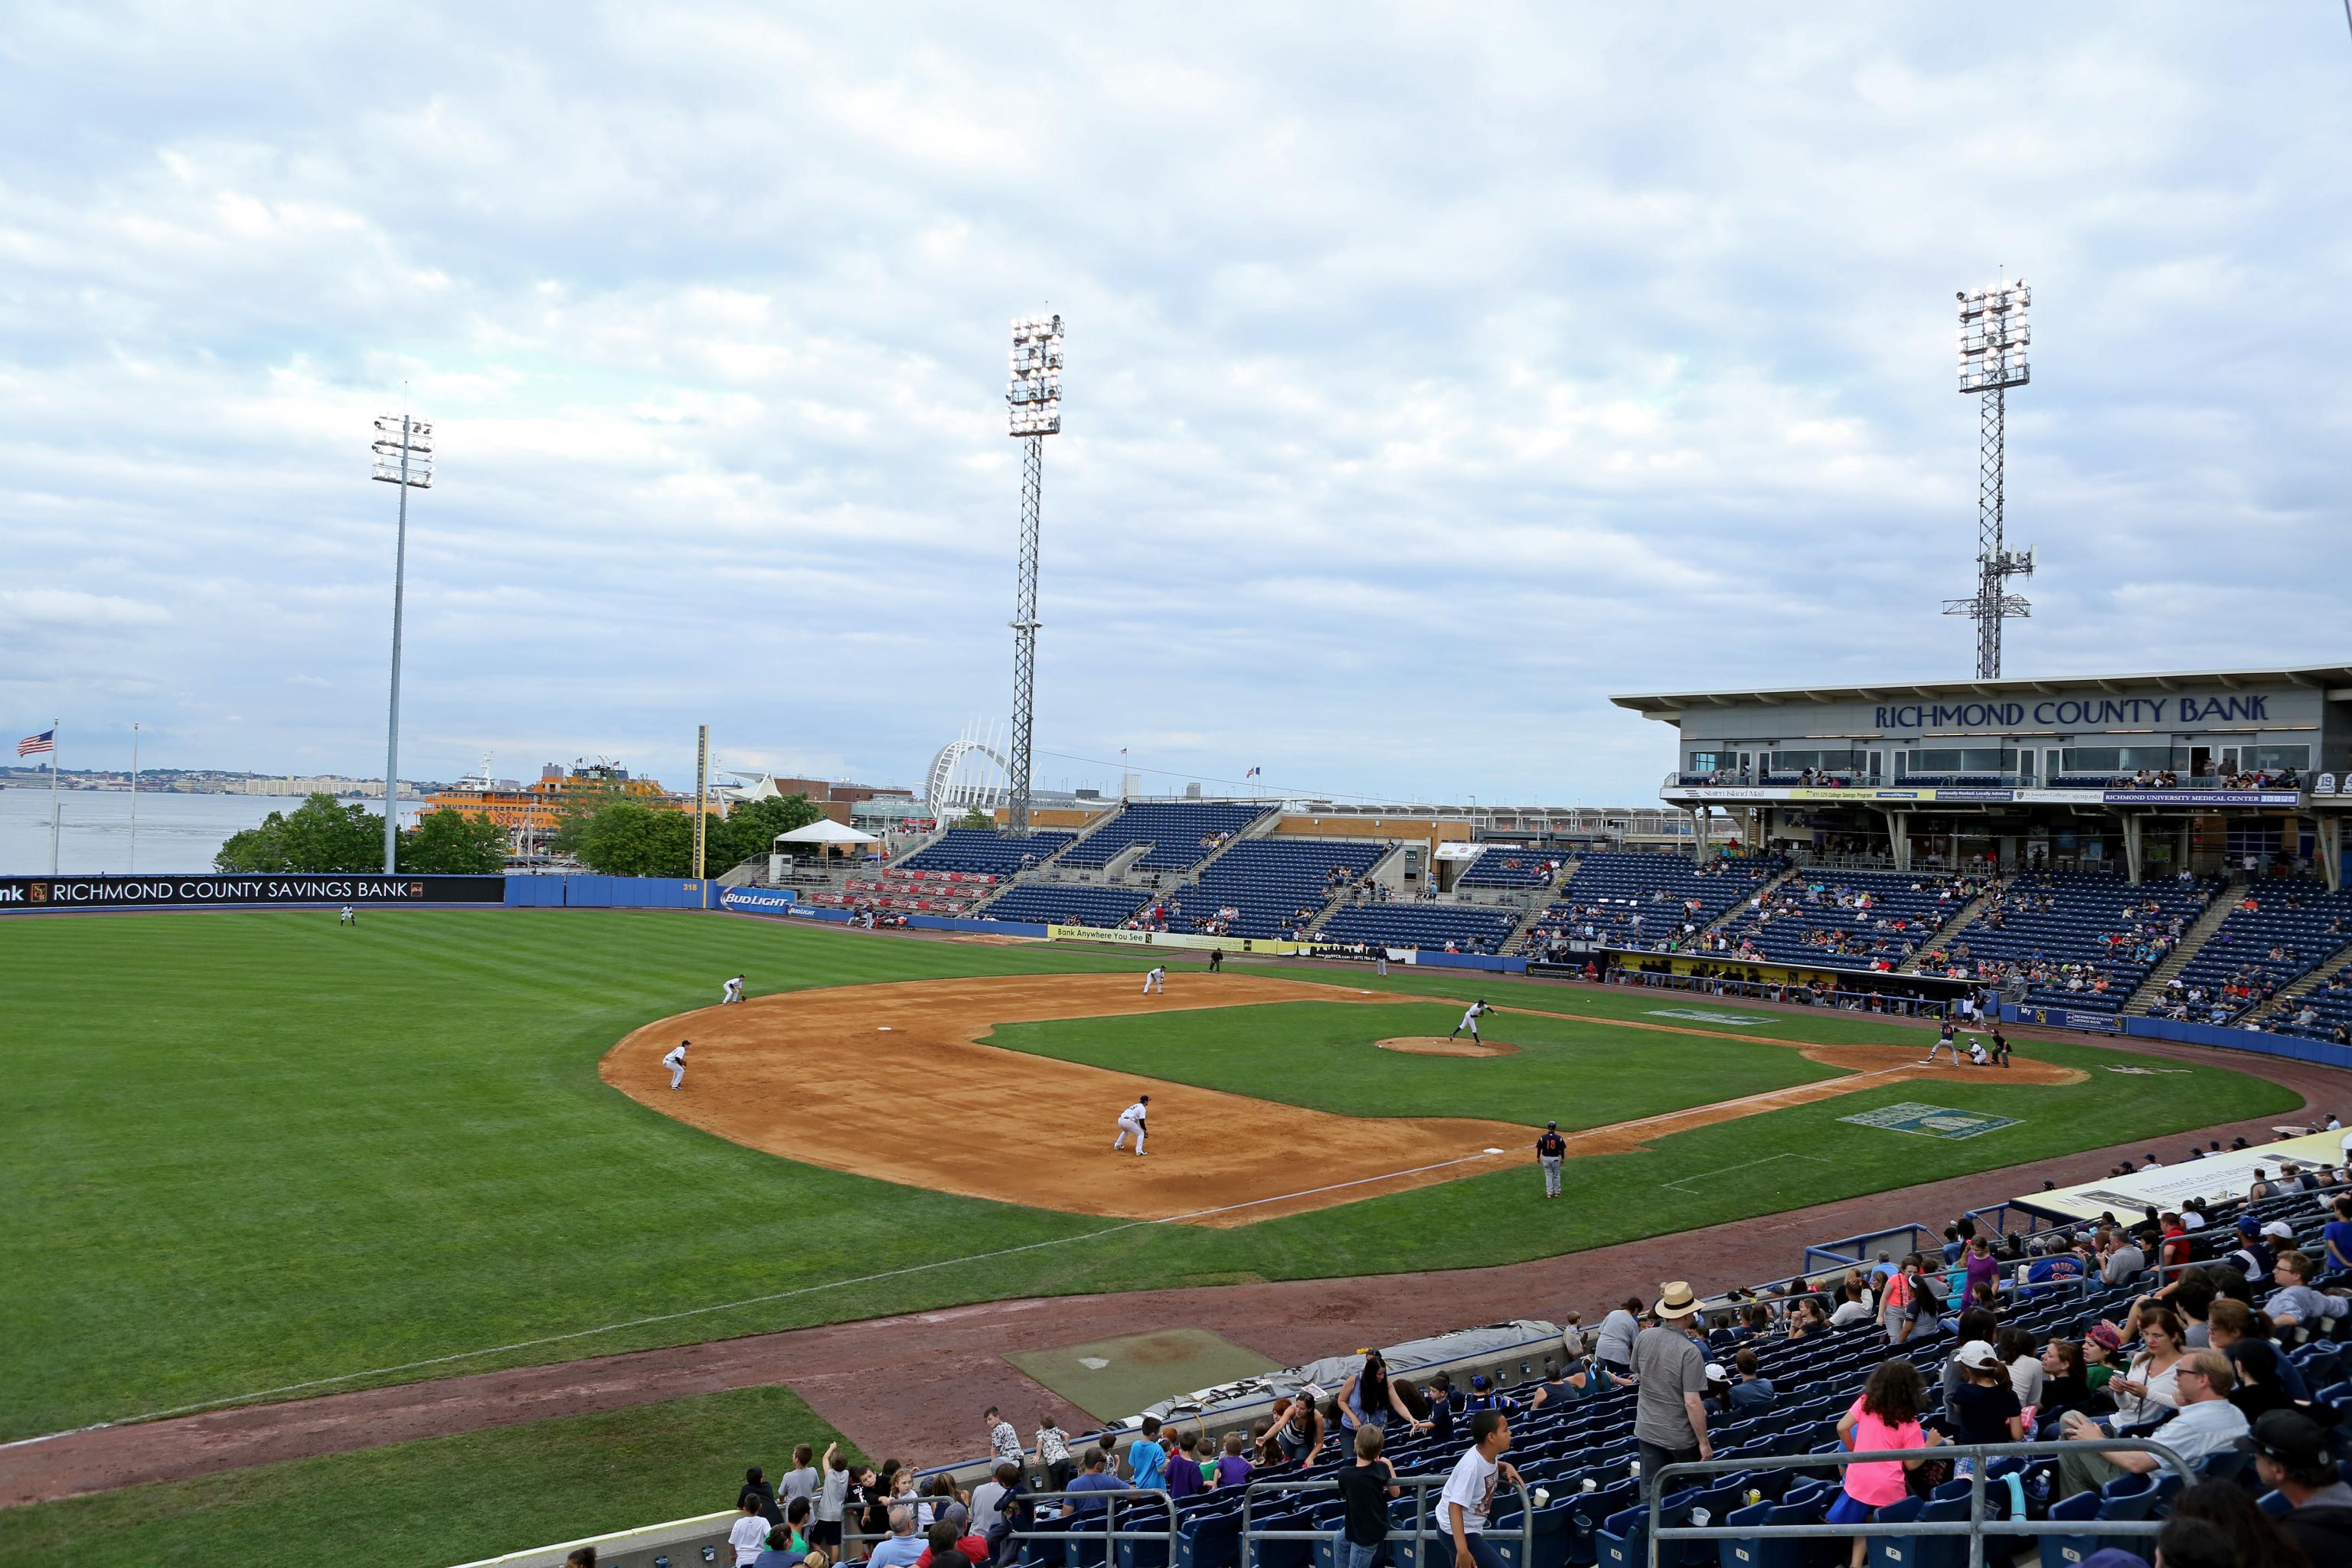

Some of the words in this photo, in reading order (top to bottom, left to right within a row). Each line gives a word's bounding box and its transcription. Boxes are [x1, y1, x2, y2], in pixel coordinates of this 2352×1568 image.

[1876, 703, 2024, 728] RICHMOND
[2034, 697, 2167, 724] COUNTY
[2180, 695, 2269, 722] BANK
[2321, 776, 2331, 786] 19
[54, 884, 173, 900] RICHMOND
[180, 881, 263, 898] COUNTY
[268, 882, 351, 897] SAVINGS
[358, 882, 407, 897] BANK
[726, 893, 752, 904] BUD
[751, 895, 788, 906] LIGHT
[1057, 928, 1075, 937] Bank
[1076, 929, 1112, 940] Anywhere
[1113, 932, 1128, 941] You
[1129, 933, 1143, 942] See
[2020, 1008, 2031, 1016] My
[1547, 1139, 1556, 1149] 18
[2067, 1550, 2075, 1560] Q
